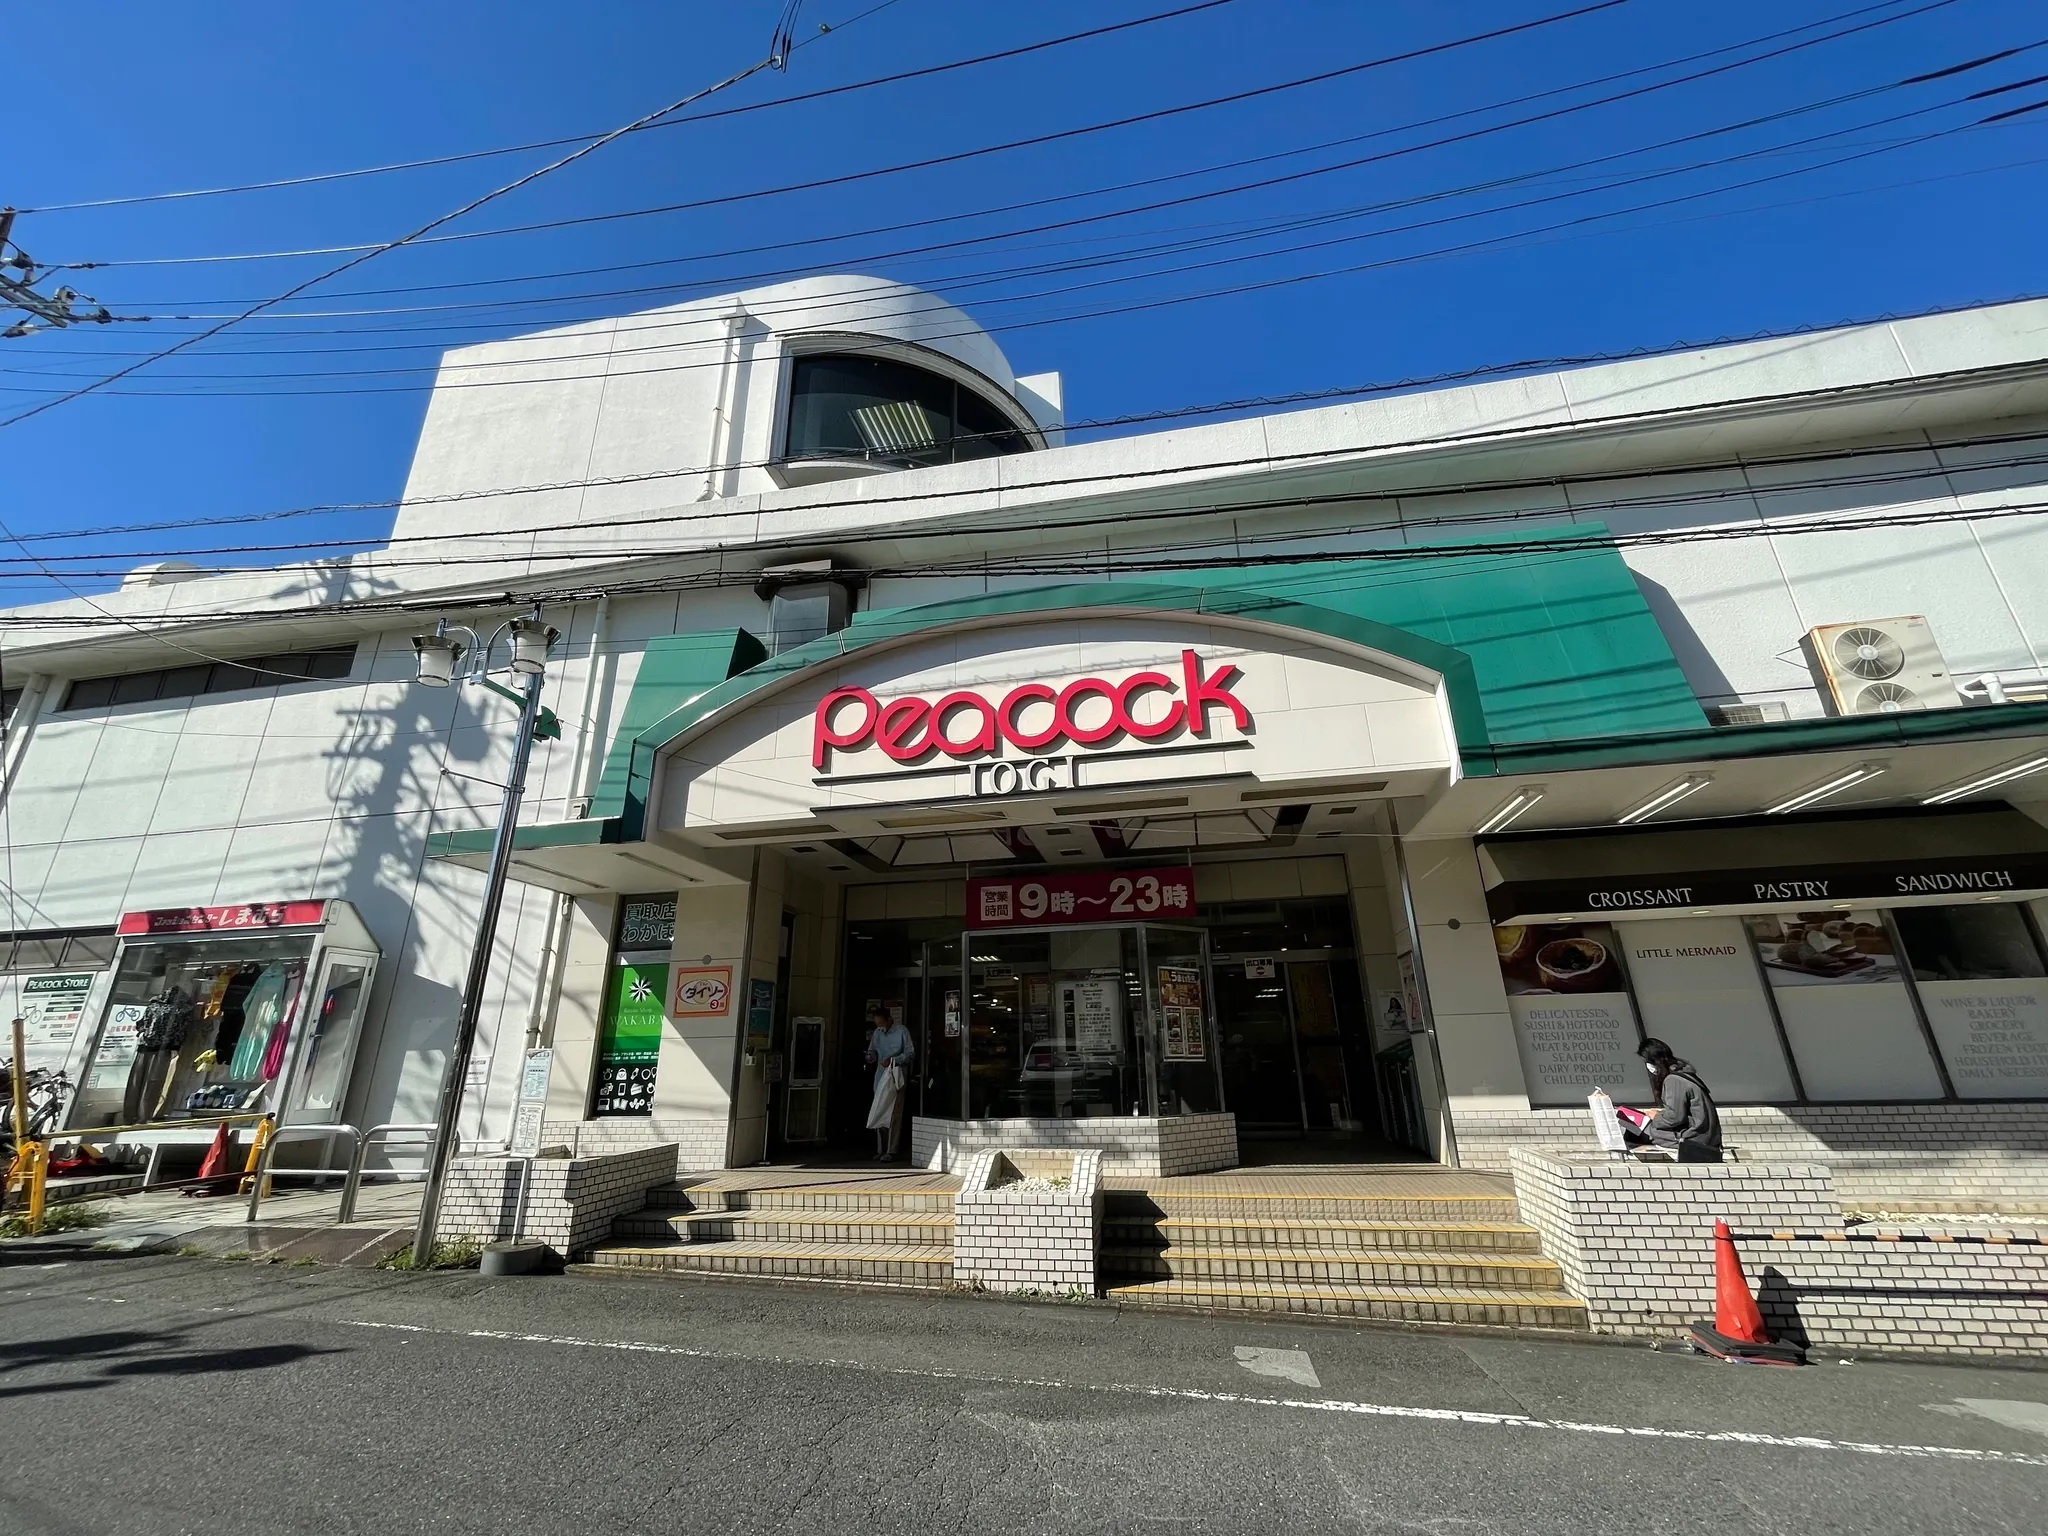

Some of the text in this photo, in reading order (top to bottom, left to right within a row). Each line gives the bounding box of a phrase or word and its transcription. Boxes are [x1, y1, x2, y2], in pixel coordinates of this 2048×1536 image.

[968, 755, 1076, 797] IOGI
[1588, 871, 2014, 908] CROISSANT PASTRY SANDWICH
[984, 891, 1009, 903] 営業
[218, 905, 287, 926] しまむら
[625, 902, 677, 921] 買取店
[984, 904, 1009, 917] 時間
[621, 922, 675, 942] わかば
[1636, 945, 1736, 960] LITTLE MERMAID
[27, 977, 89, 990] PEACOCK STORE
[685, 986, 724, 999] ダイソー
[1941, 998, 1975, 1008] WINE
[1989, 996, 2037, 1008] LIQUOR
[1529, 1009, 1609, 1020] DELICATESSEN
[1967, 1008, 2016, 1019] BAKERY
[1524, 1020, 1555, 1030] SUSHI
[1557, 1020, 1565, 1030] &
[1969, 1020, 2025, 1031] GROCERY
[1532, 1031, 1618, 1041] FRESH PRODUCE
[1970, 1032, 2036, 1042] BEVERAGE
[1531, 1041, 1621, 1052] MEAT & POULTRY
[1962, 1044, 2013, 1054] FROZEN
[1552, 1053, 1605, 1063] SEAFOOD
[1539, 1063, 1626, 1074] DAIRY PRODUCT
[1958, 1068, 1995, 1079] DAILY
[1544, 1075, 1625, 1085] CHILLED FOOD
